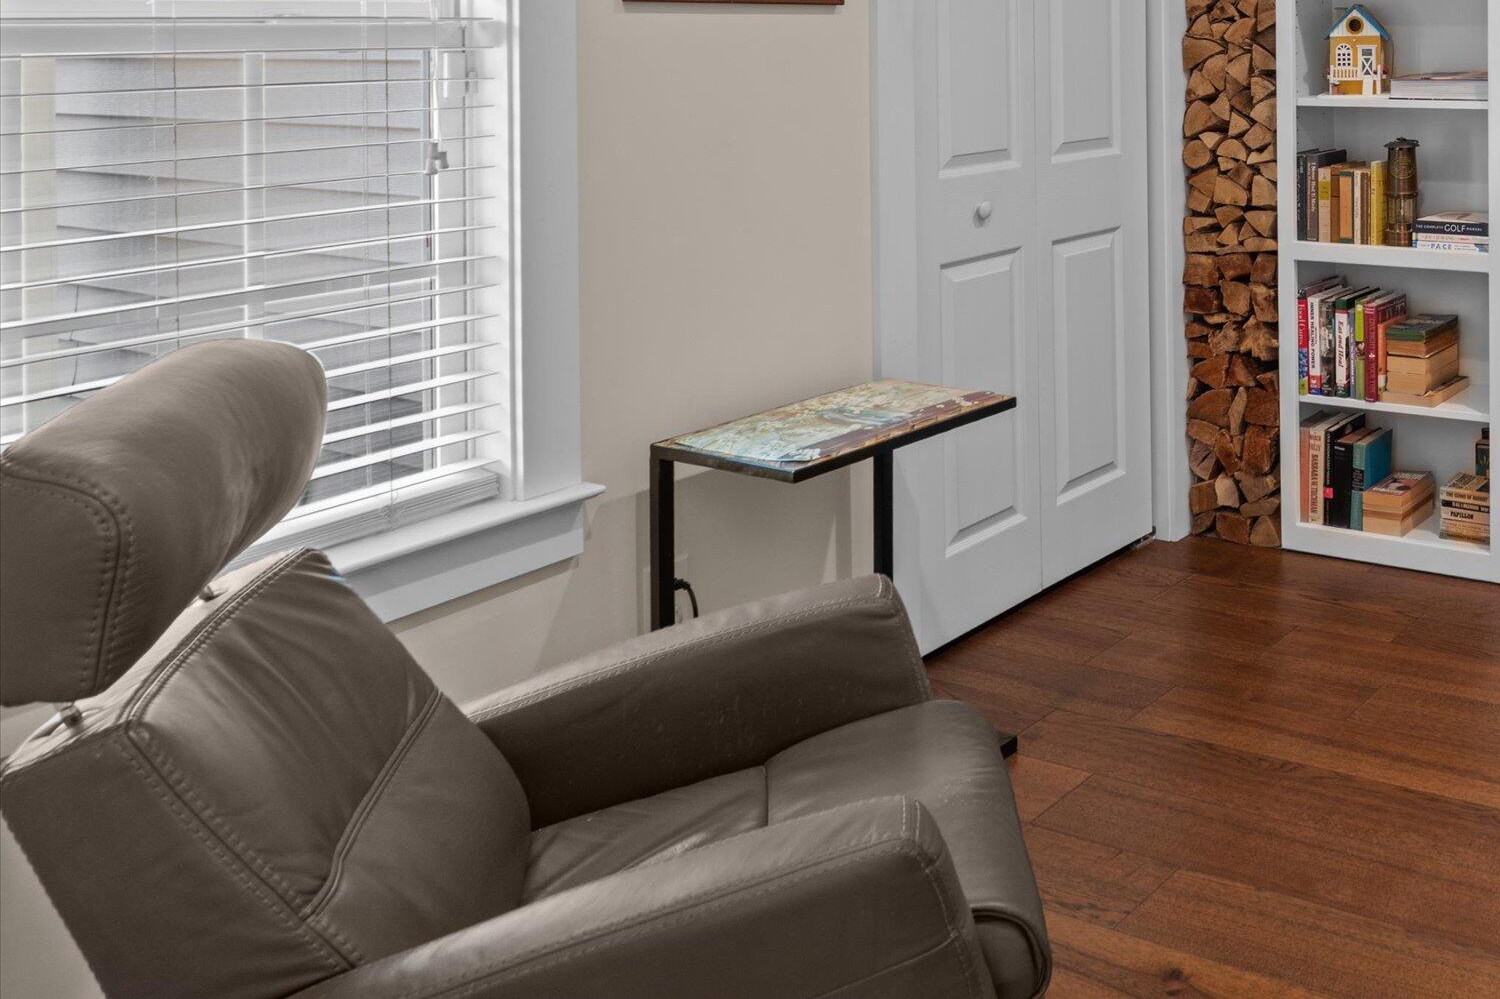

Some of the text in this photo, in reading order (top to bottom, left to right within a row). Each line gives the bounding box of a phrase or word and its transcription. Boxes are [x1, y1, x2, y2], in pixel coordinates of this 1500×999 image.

[1444, 224, 1466, 232] GOLF
[1430, 242, 1452, 250] PACE
[1450, 511, 1474, 519] PAPILLON
